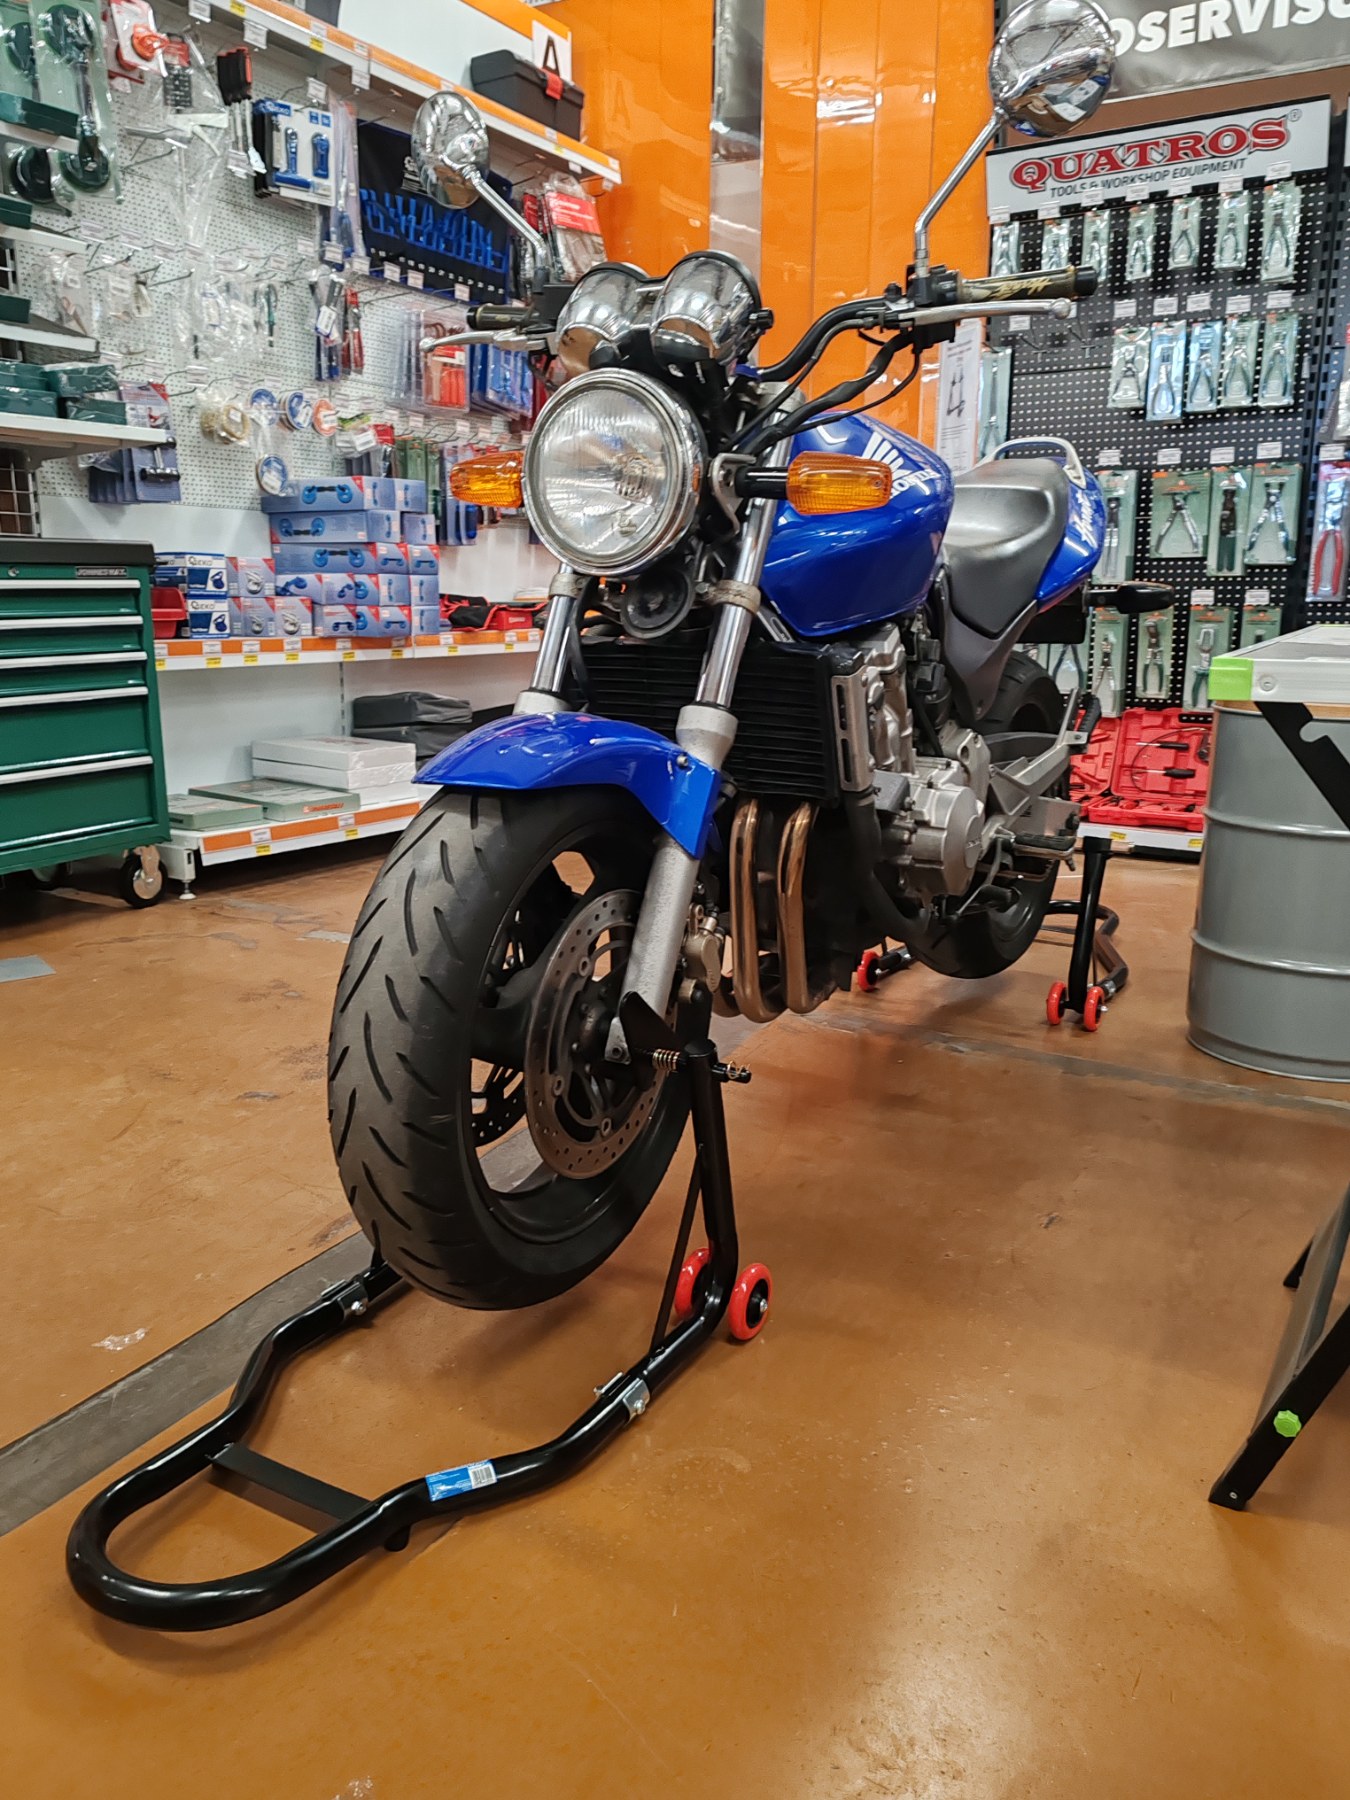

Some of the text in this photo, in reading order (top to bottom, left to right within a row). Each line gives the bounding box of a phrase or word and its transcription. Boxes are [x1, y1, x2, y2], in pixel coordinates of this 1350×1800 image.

[1010, 117, 1290, 193] QUATROS
[1050, 181, 1087, 198] TOOLS
[1100, 169, 1170, 189] WORKSHOP
[1172, 157, 1247, 180] EQUIPMENT
